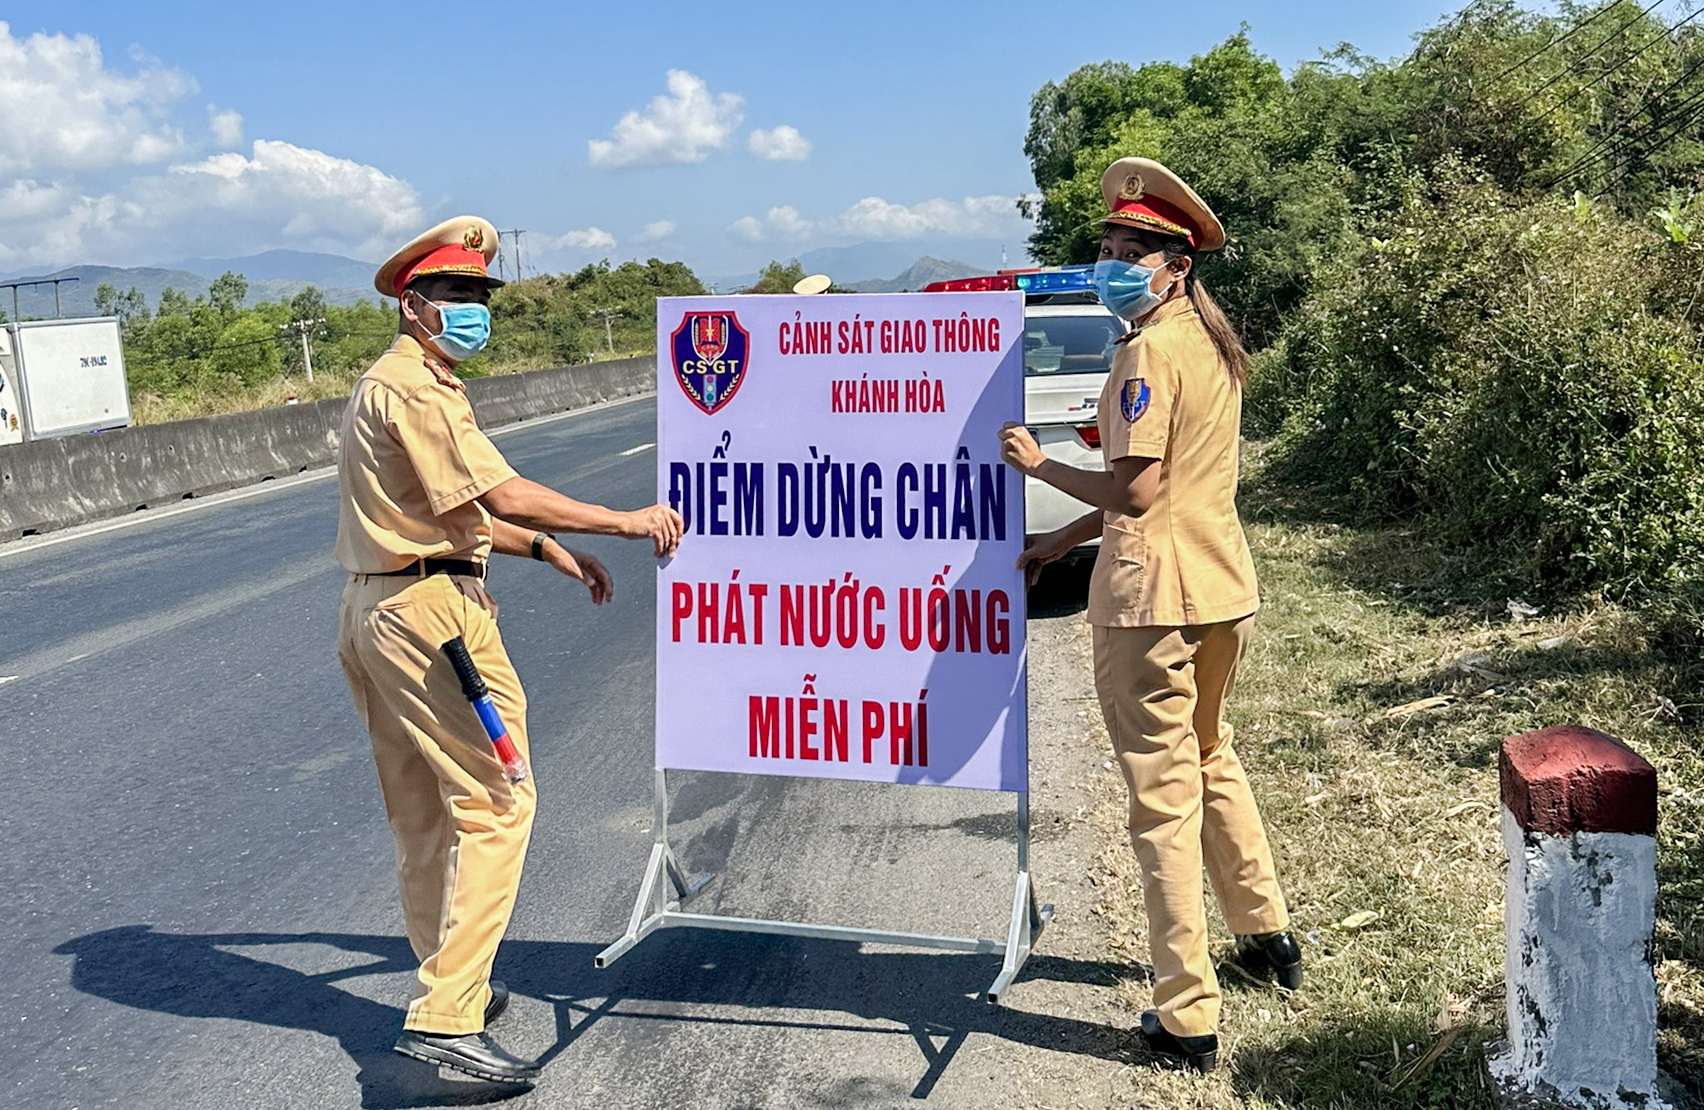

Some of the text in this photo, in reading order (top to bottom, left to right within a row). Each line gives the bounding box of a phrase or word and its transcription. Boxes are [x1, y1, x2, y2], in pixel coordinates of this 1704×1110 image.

[779, 311, 1000, 355] CẢNH SÁT GIAO THÔNG
[831, 370, 946, 413] KHÁNH HÒA
[668, 430, 1007, 541] ĐIỂM DỪNG CHÂN
[672, 565, 1011, 655] PHÁT NƯỚC UỐNG
[748, 673, 929, 768] MIỄN PHÍ
